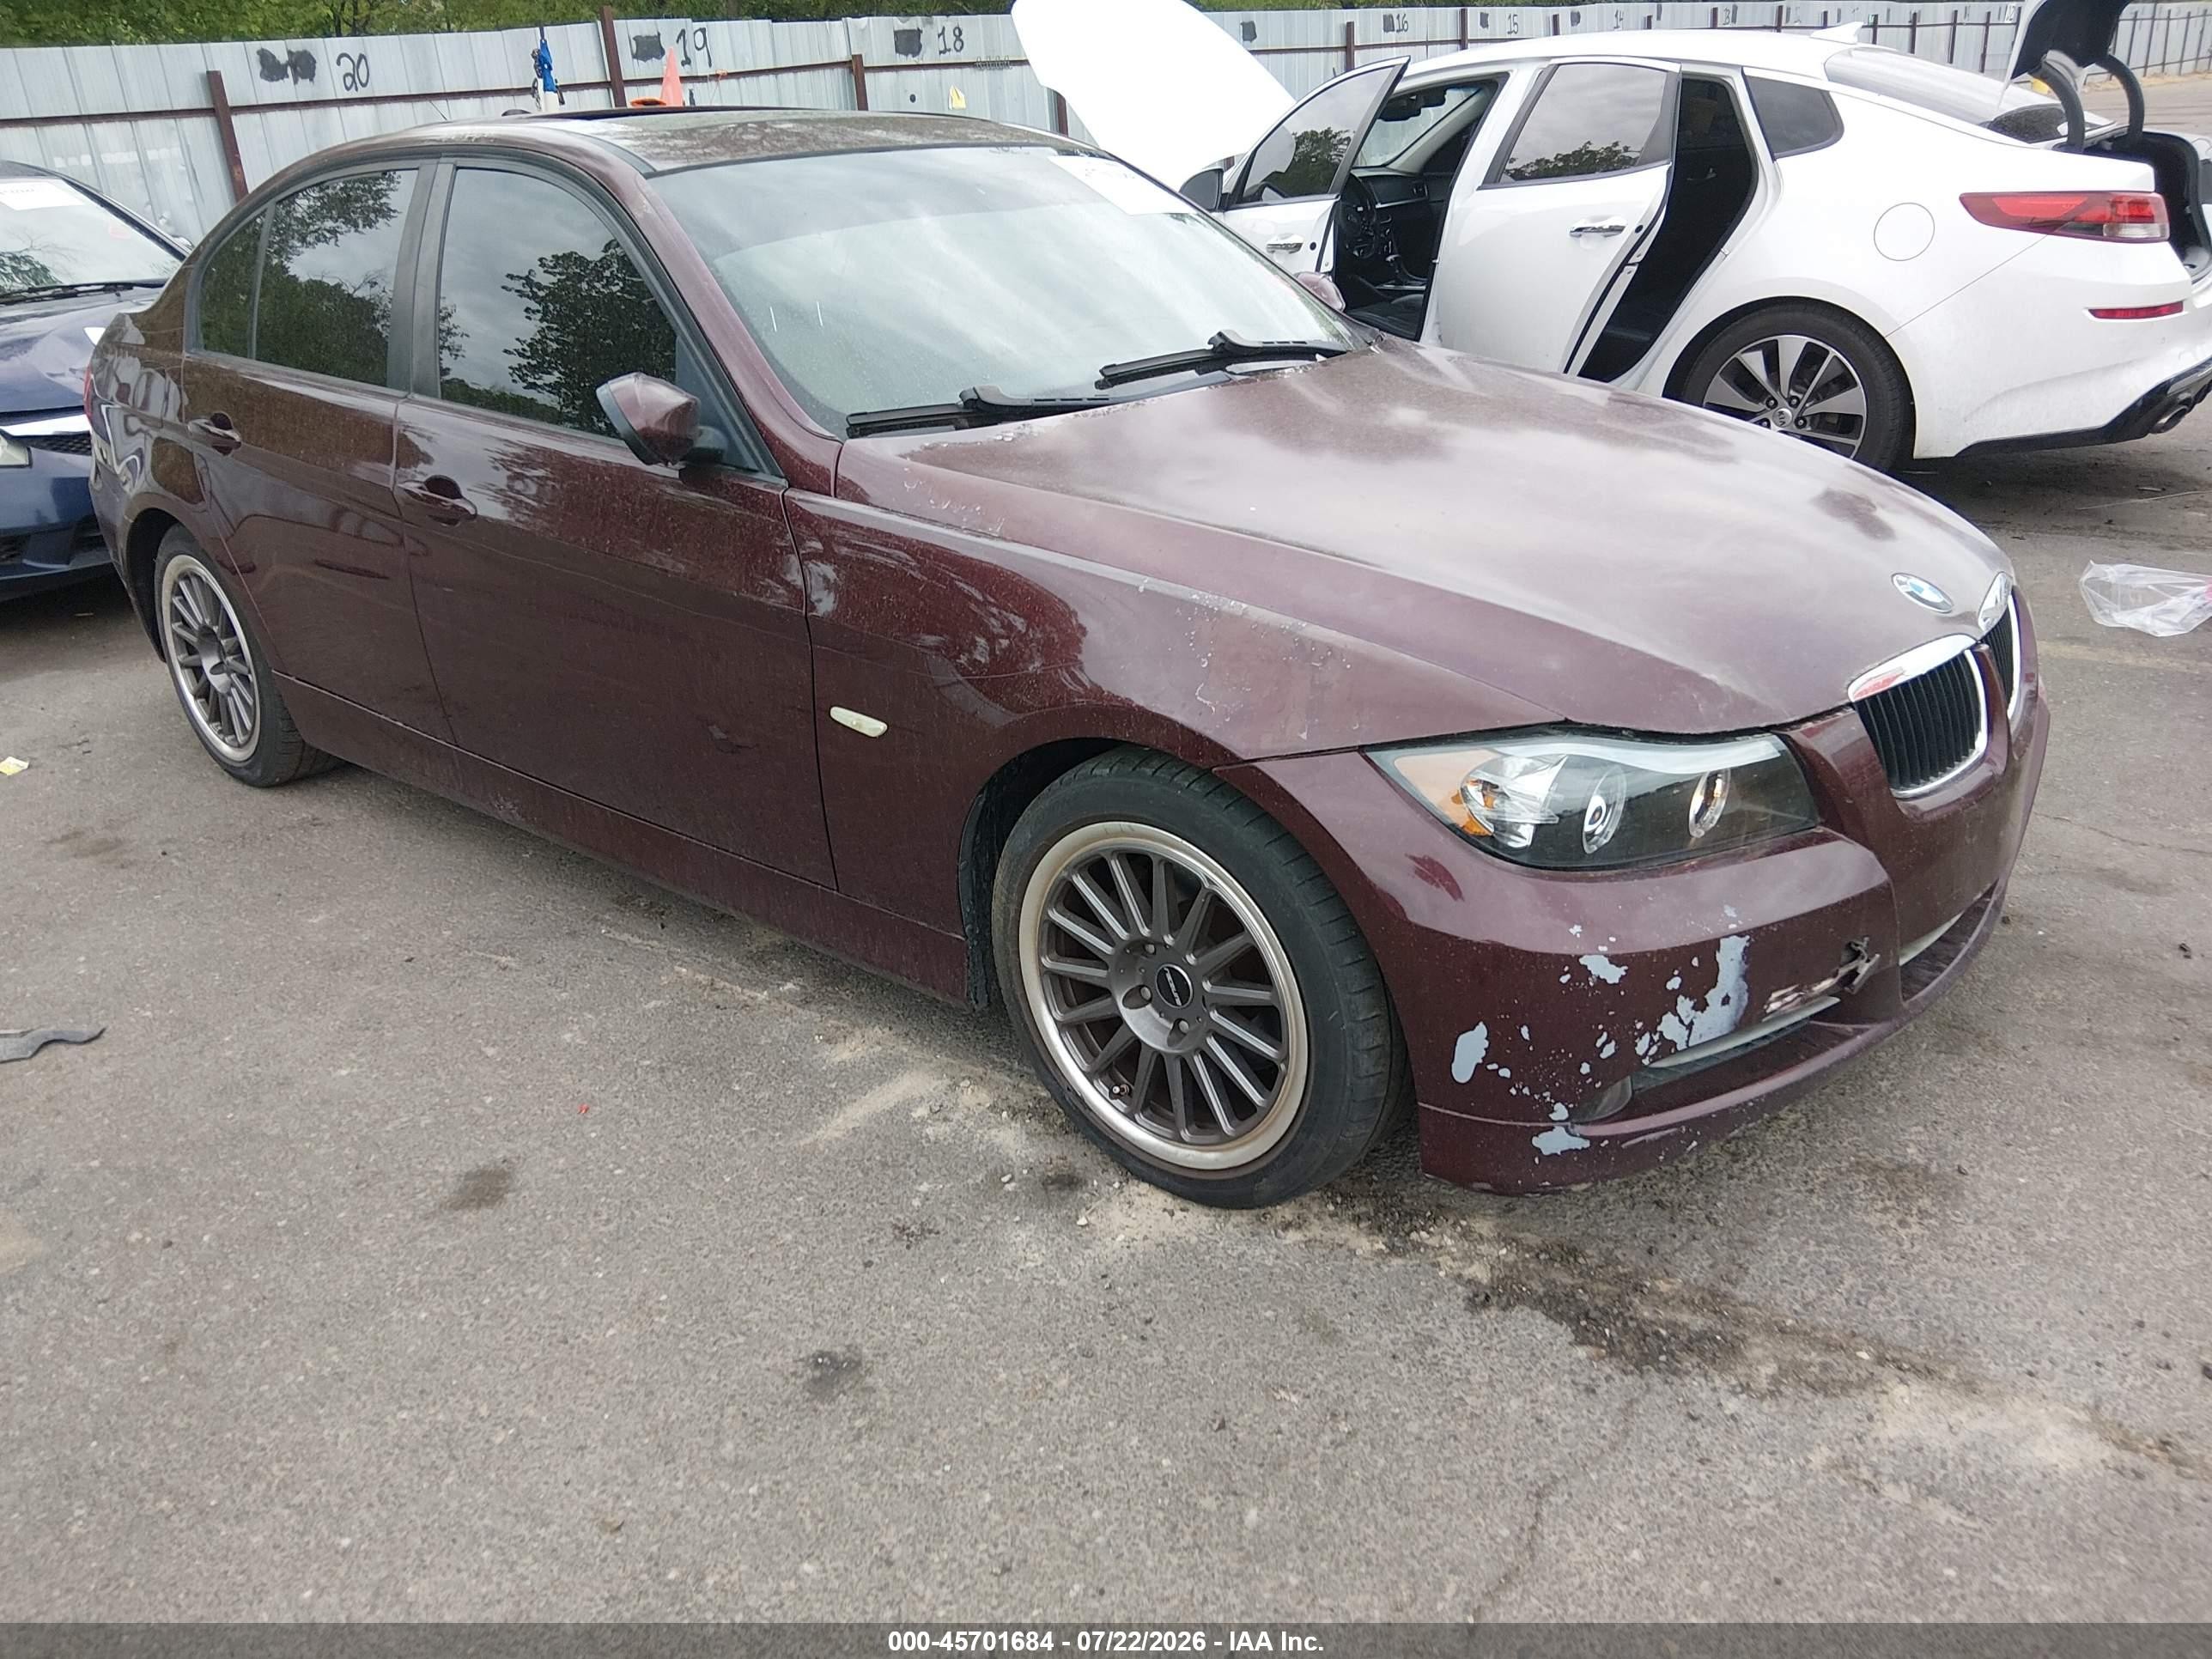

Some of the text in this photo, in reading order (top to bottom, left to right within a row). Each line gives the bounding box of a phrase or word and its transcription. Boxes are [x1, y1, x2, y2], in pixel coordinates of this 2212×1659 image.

[1395, 13, 1409, 33] 16
[1506, 13, 1519, 35] 15
[676, 27, 712, 68] 19
[938, 25, 964, 55] 18
[336, 52, 369, 92] 20
[1778, 410, 1786, 427] KIA
